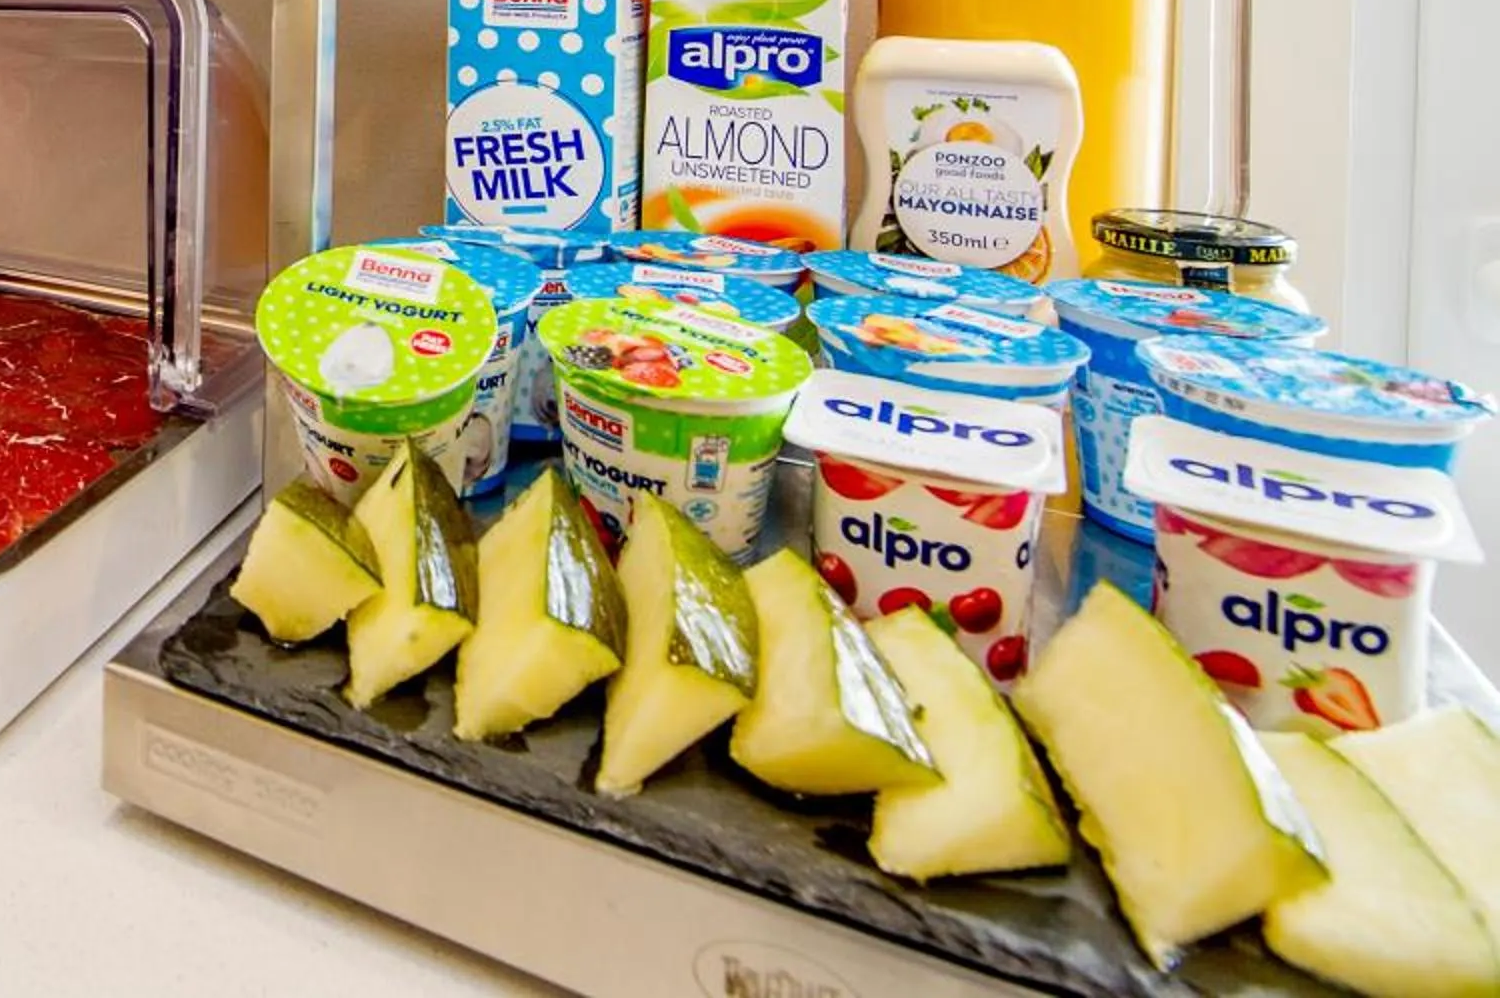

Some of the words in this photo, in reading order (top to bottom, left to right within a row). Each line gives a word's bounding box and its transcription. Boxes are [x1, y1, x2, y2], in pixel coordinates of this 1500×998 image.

[680, 31, 811, 81] alpro
[517, 117, 543, 131] FAT
[708, 105, 773, 121] ROASTED
[453, 128, 585, 168] FRESH
[657, 115, 829, 171] ALMOND
[935, 152, 1006, 168] PONZOO
[471, 165, 579, 201] MILK
[671, 159, 812, 190] UNSWEETENED
[935, 167, 967, 179] good
[969, 167, 1006, 181] foods
[898, 195, 1039, 222] MAYONNAISE
[945, 185, 975, 201] ALL
[984, 188, 1040, 208] TASTY
[927, 228, 988, 250] 350ml
[360, 257, 432, 284] Benna
[306, 280, 369, 306] LIGHT
[373, 297, 466, 323] YOGURT
[823, 398, 1034, 447] alpro
[580, 449, 668, 496] YOGURT
[1169, 456, 1436, 520] alpro
[840, 512, 972, 572] alpro
[1220, 588, 1390, 656] alpro
